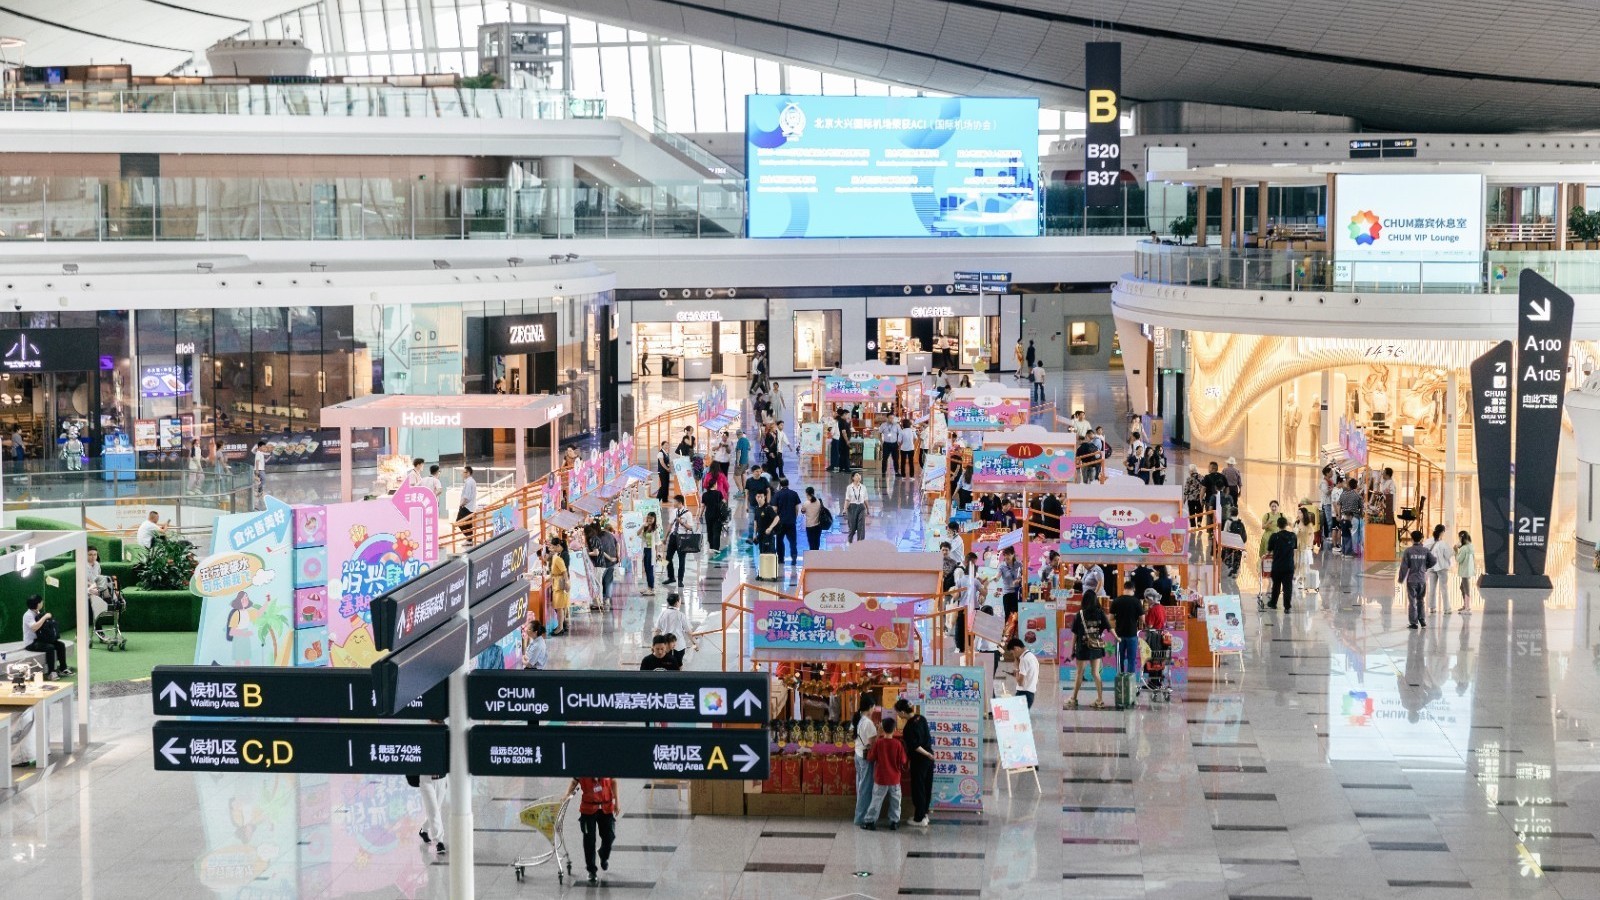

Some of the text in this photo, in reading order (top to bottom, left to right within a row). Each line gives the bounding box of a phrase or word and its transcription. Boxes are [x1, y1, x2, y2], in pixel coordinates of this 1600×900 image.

[1089, 90, 1117, 123] B
[1087, 144, 1119, 158] B20
[1087, 171, 1119, 186] B37
[1383, 217, 1467, 229] CHUM嘉宾休息室
[1388, 233, 1459, 243] CHUM VIP Lounge
[676, 311, 723, 322] CHANEL
[911, 306, 954, 317] CHANEL
[415, 330, 437, 341] C D
[509, 324, 545, 344] ZEGNA
[1524, 335, 1562, 351] A100
[1523, 365, 1561, 381] A105
[1518, 517, 1545, 533] 2F
[342, 560, 366, 572] 2025
[190, 682, 237, 698] 候机区
[243, 683, 263, 707] B
[497, 688, 535, 698] CHUM
[190, 699, 240, 709] Waiting Area
[567, 692, 695, 709] CHUM嘉宾休息室
[485, 701, 549, 715] VIP Lounge
[189, 739, 237, 755] 候机区
[242, 740, 293, 768] C,D
[653, 745, 701, 761] 候机区
[190, 756, 240, 765] Waiting Area
[379, 754, 390, 763] Up
[400, 754, 421, 762] 740m
[490, 756, 501, 765] Up
[512, 756, 533, 764] 520m
[707, 746, 729, 770] A
[653, 761, 704, 771] Waiting Area
